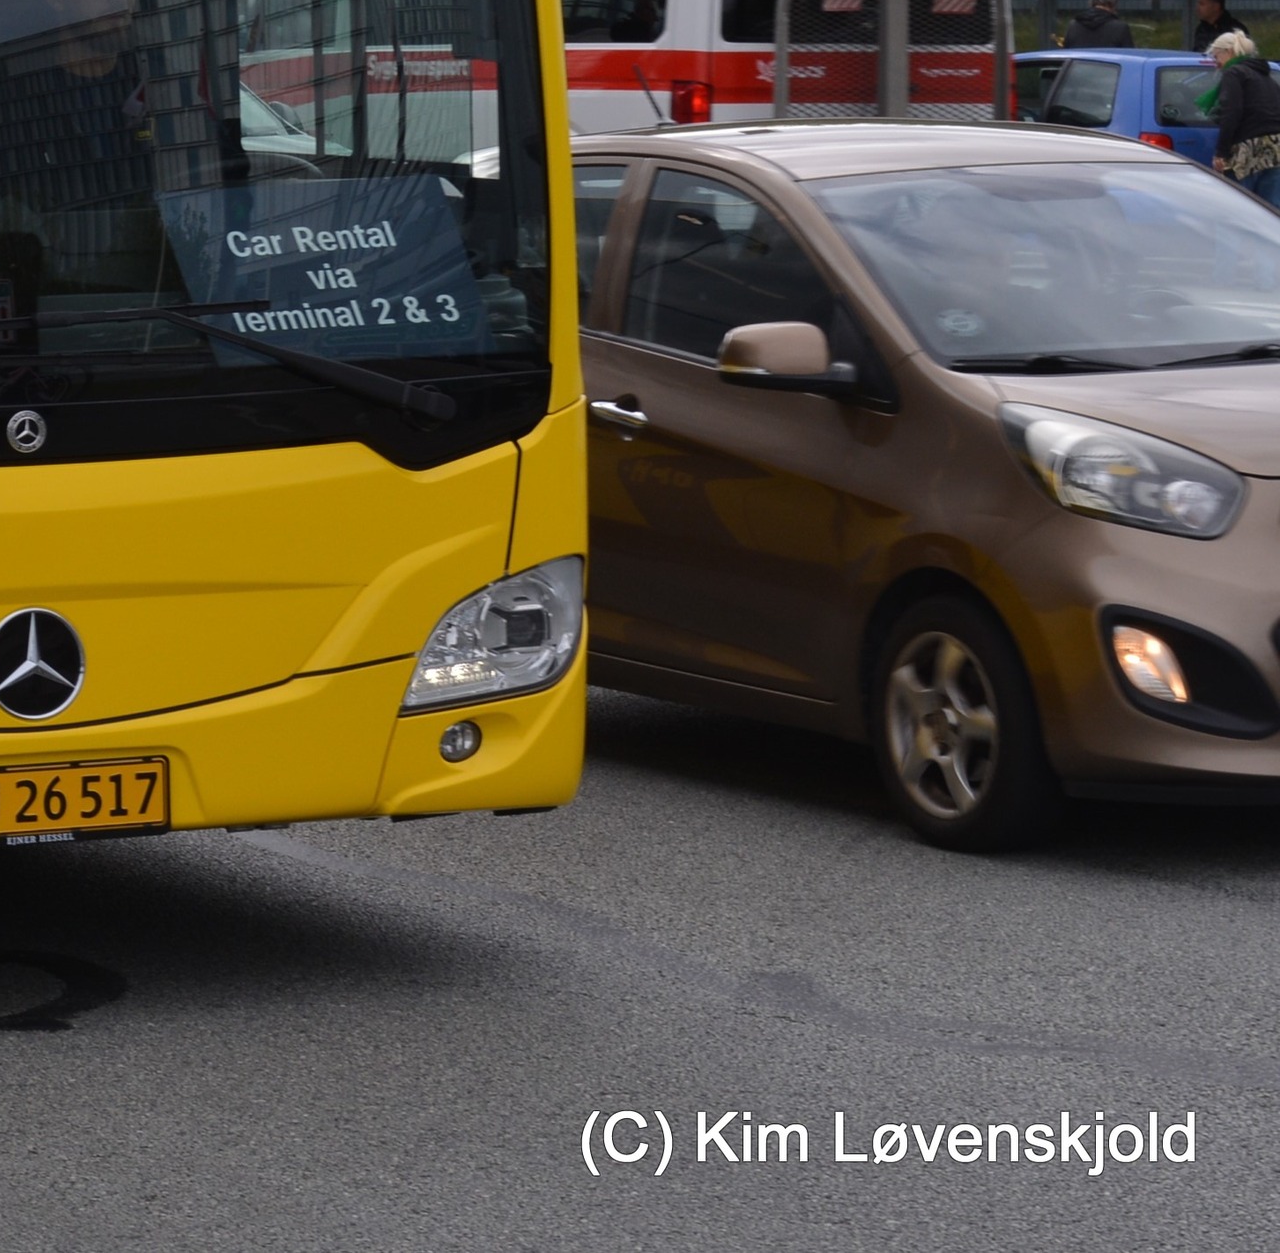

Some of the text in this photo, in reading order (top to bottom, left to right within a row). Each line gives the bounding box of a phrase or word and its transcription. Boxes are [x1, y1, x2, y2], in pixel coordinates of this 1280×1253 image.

[226, 220, 398, 258] Car Rental
[305, 263, 358, 290] via
[371, 297, 397, 325] 2
[402, 295, 431, 323] &
[436, 293, 461, 322] 3
[15, 775, 68, 824] 26
[80, 771, 158, 820] 517
[6, 832, 76, 846] EJNER HESSEL
